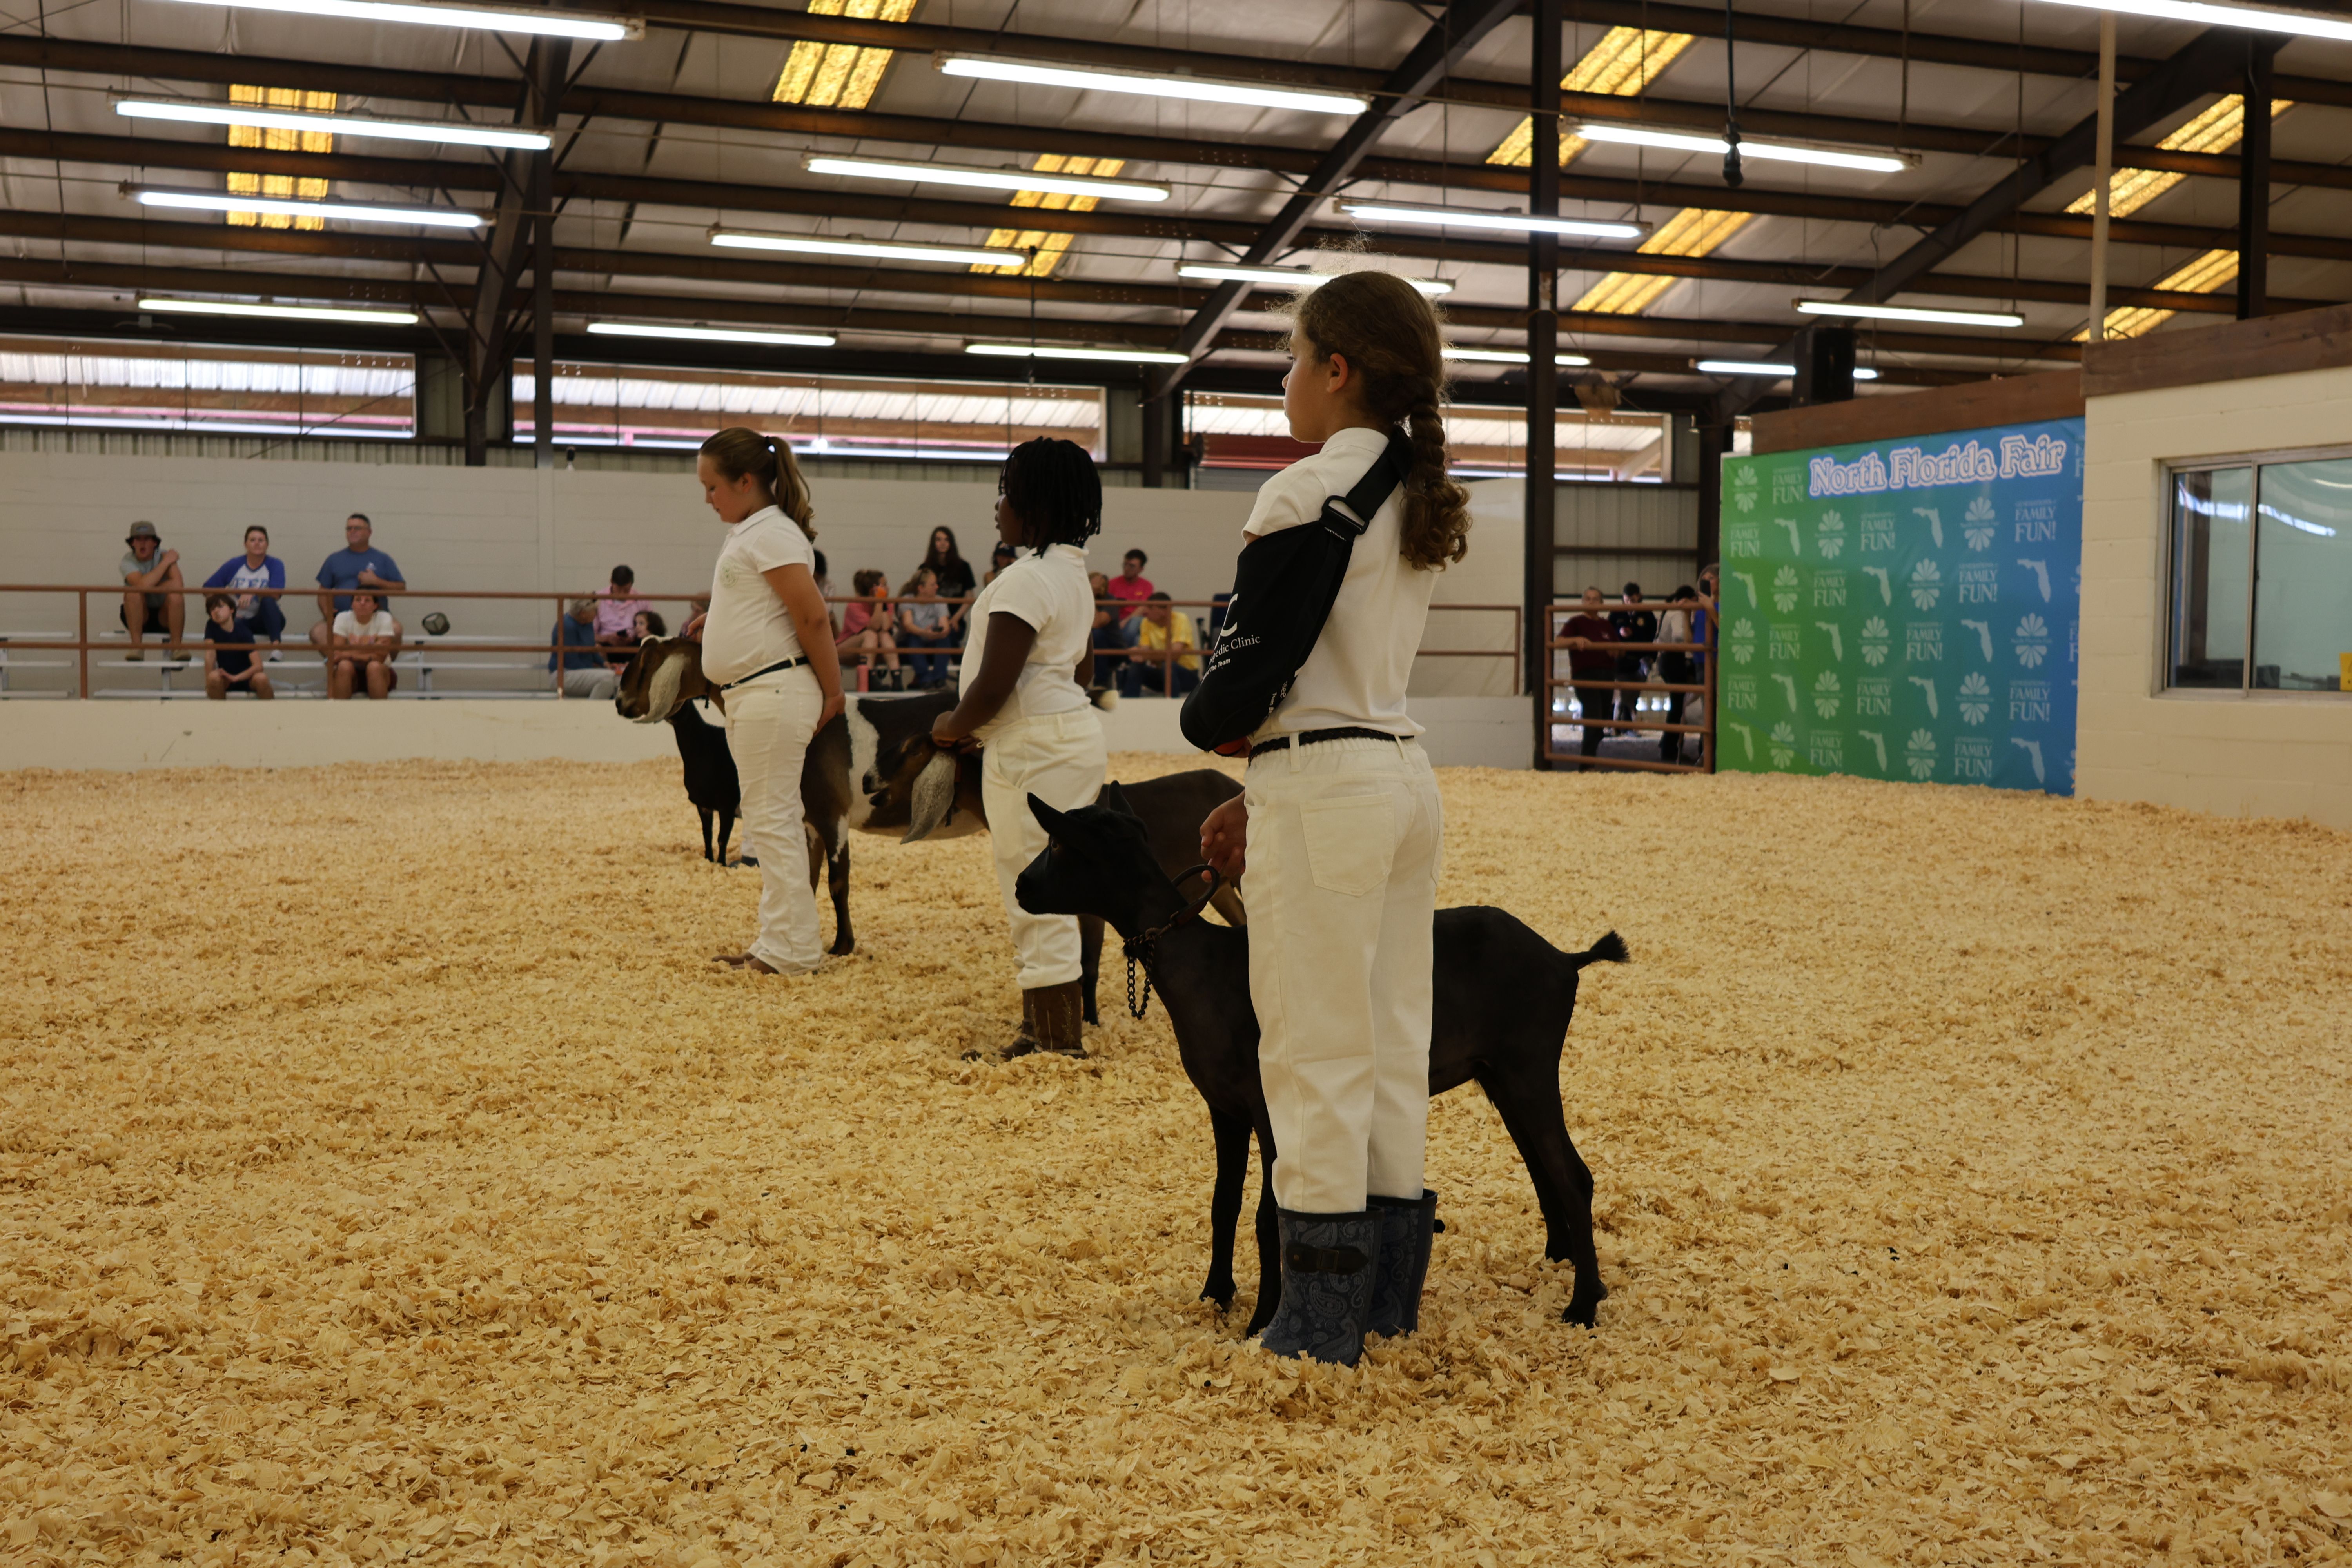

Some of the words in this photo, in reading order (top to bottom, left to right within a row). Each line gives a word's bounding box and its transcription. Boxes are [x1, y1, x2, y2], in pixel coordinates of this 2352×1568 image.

[1809, 453, 1886, 496] North
[1889, 439, 1997, 489] Florida
[1999, 434, 2066, 478] Fair
[1773, 473, 1802, 486] FAMILY
[1772, 485, 1803, 504] FUN!
[2015, 506, 2056, 521] FAMILY
[1860, 517, 1895, 532] FAMILY
[2015, 521, 2056, 543] FUN!
[1731, 528, 1759, 539] FAMILY
[1860, 532, 1895, 551] FUN!
[1730, 541, 1760, 557] FUN!
[1814, 576, 1845, 588] FAMILY
[1959, 570, 1998, 583] FAMILY
[1814, 588, 1847, 607] FUN!
[1959, 583, 1998, 603] FUN!
[1230, 634, 1261, 650] Clinic
[1770, 630, 1799, 641] FAMILY
[1906, 629, 1942, 641] FAMILY
[1769, 642, 1800, 659] FUN!
[1906, 642, 1942, 661] FUN!
[1218, 658, 1231, 668] Team
[1728, 681, 1756, 692] FAMILY
[1857, 684, 1891, 696] FAMILY
[2010, 687, 2051, 700] FAMILY
[1728, 693, 1757, 710] FUN!
[1857, 697, 1891, 716] FUN!
[2009, 702, 2051, 722] FUN!
[1811, 737, 1842, 748] FAMILY
[1955, 744, 1992, 757] FAMILY
[1810, 749, 1842, 768] FUN!
[1954, 758, 1992, 778] FUN!
